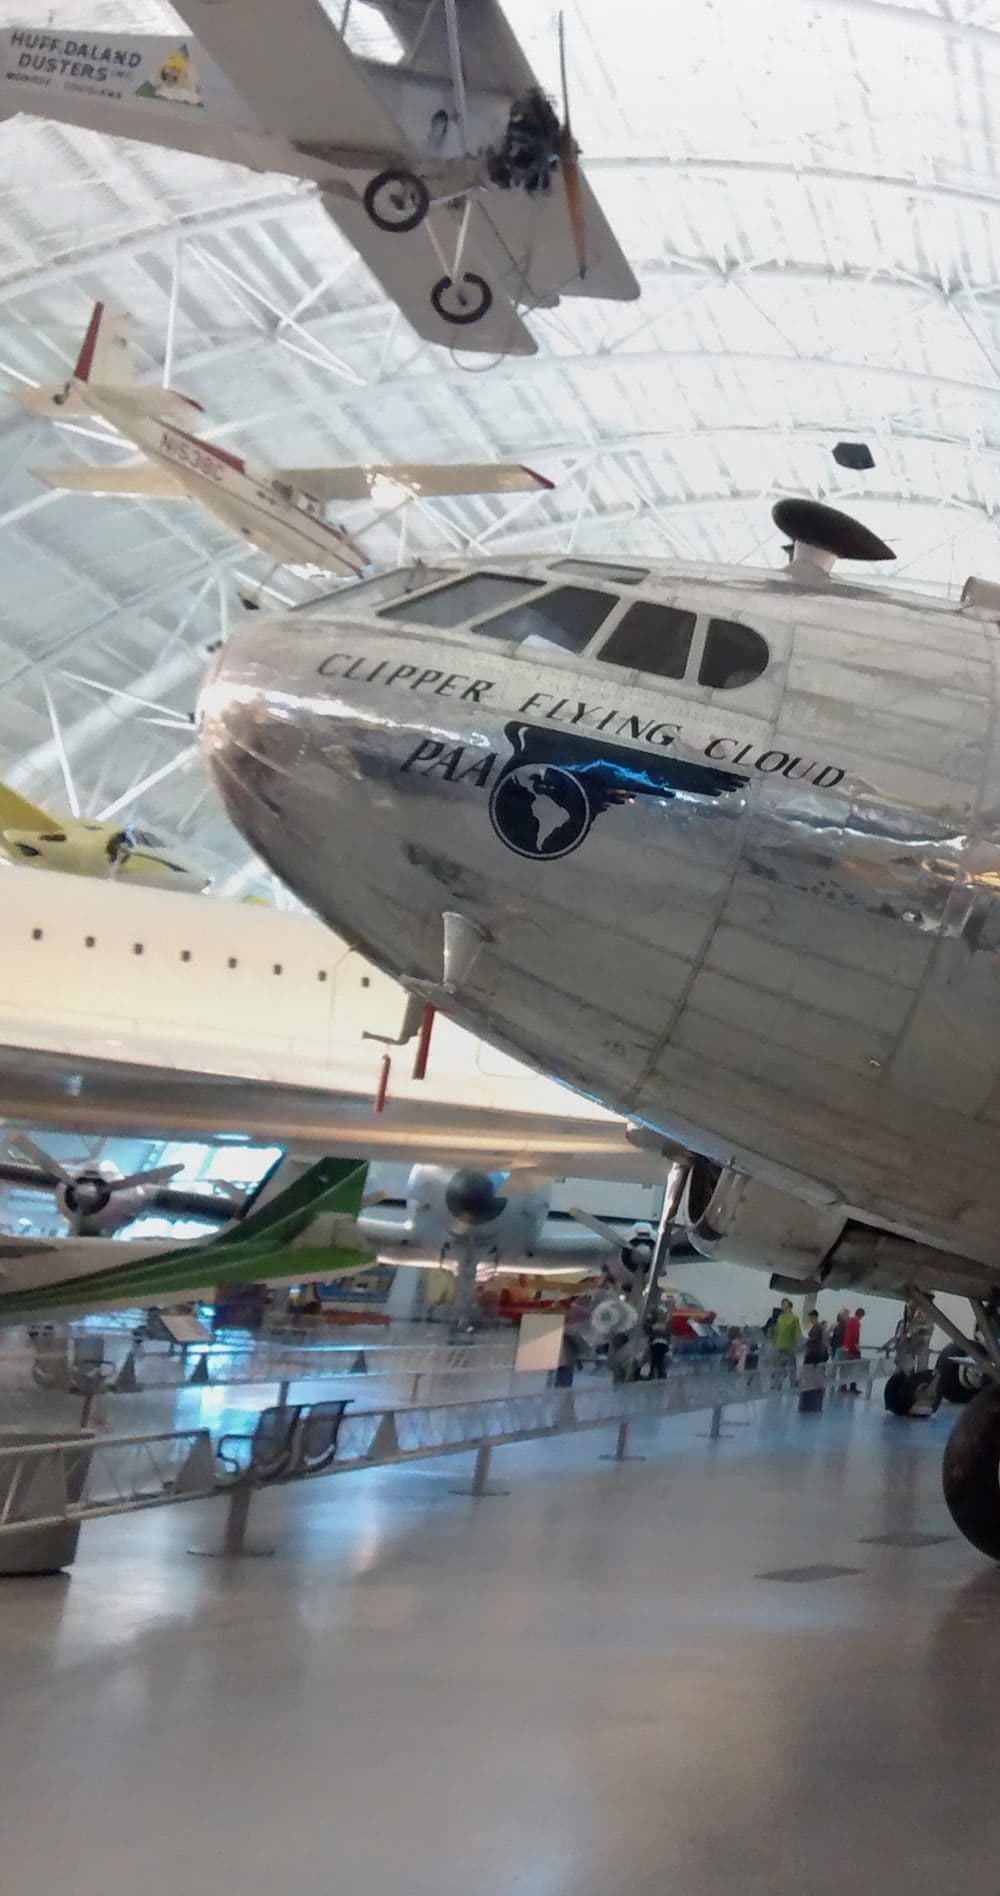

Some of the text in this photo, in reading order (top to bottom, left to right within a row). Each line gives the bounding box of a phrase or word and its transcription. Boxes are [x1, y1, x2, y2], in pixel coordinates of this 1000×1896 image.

[10, 31, 142, 68] HUFF DALAND
[18, 53, 108, 82] DUSTERS
[316, 653, 846, 789] CLIPPER FLYING CLOUD
[400, 738, 499, 787] PAA
